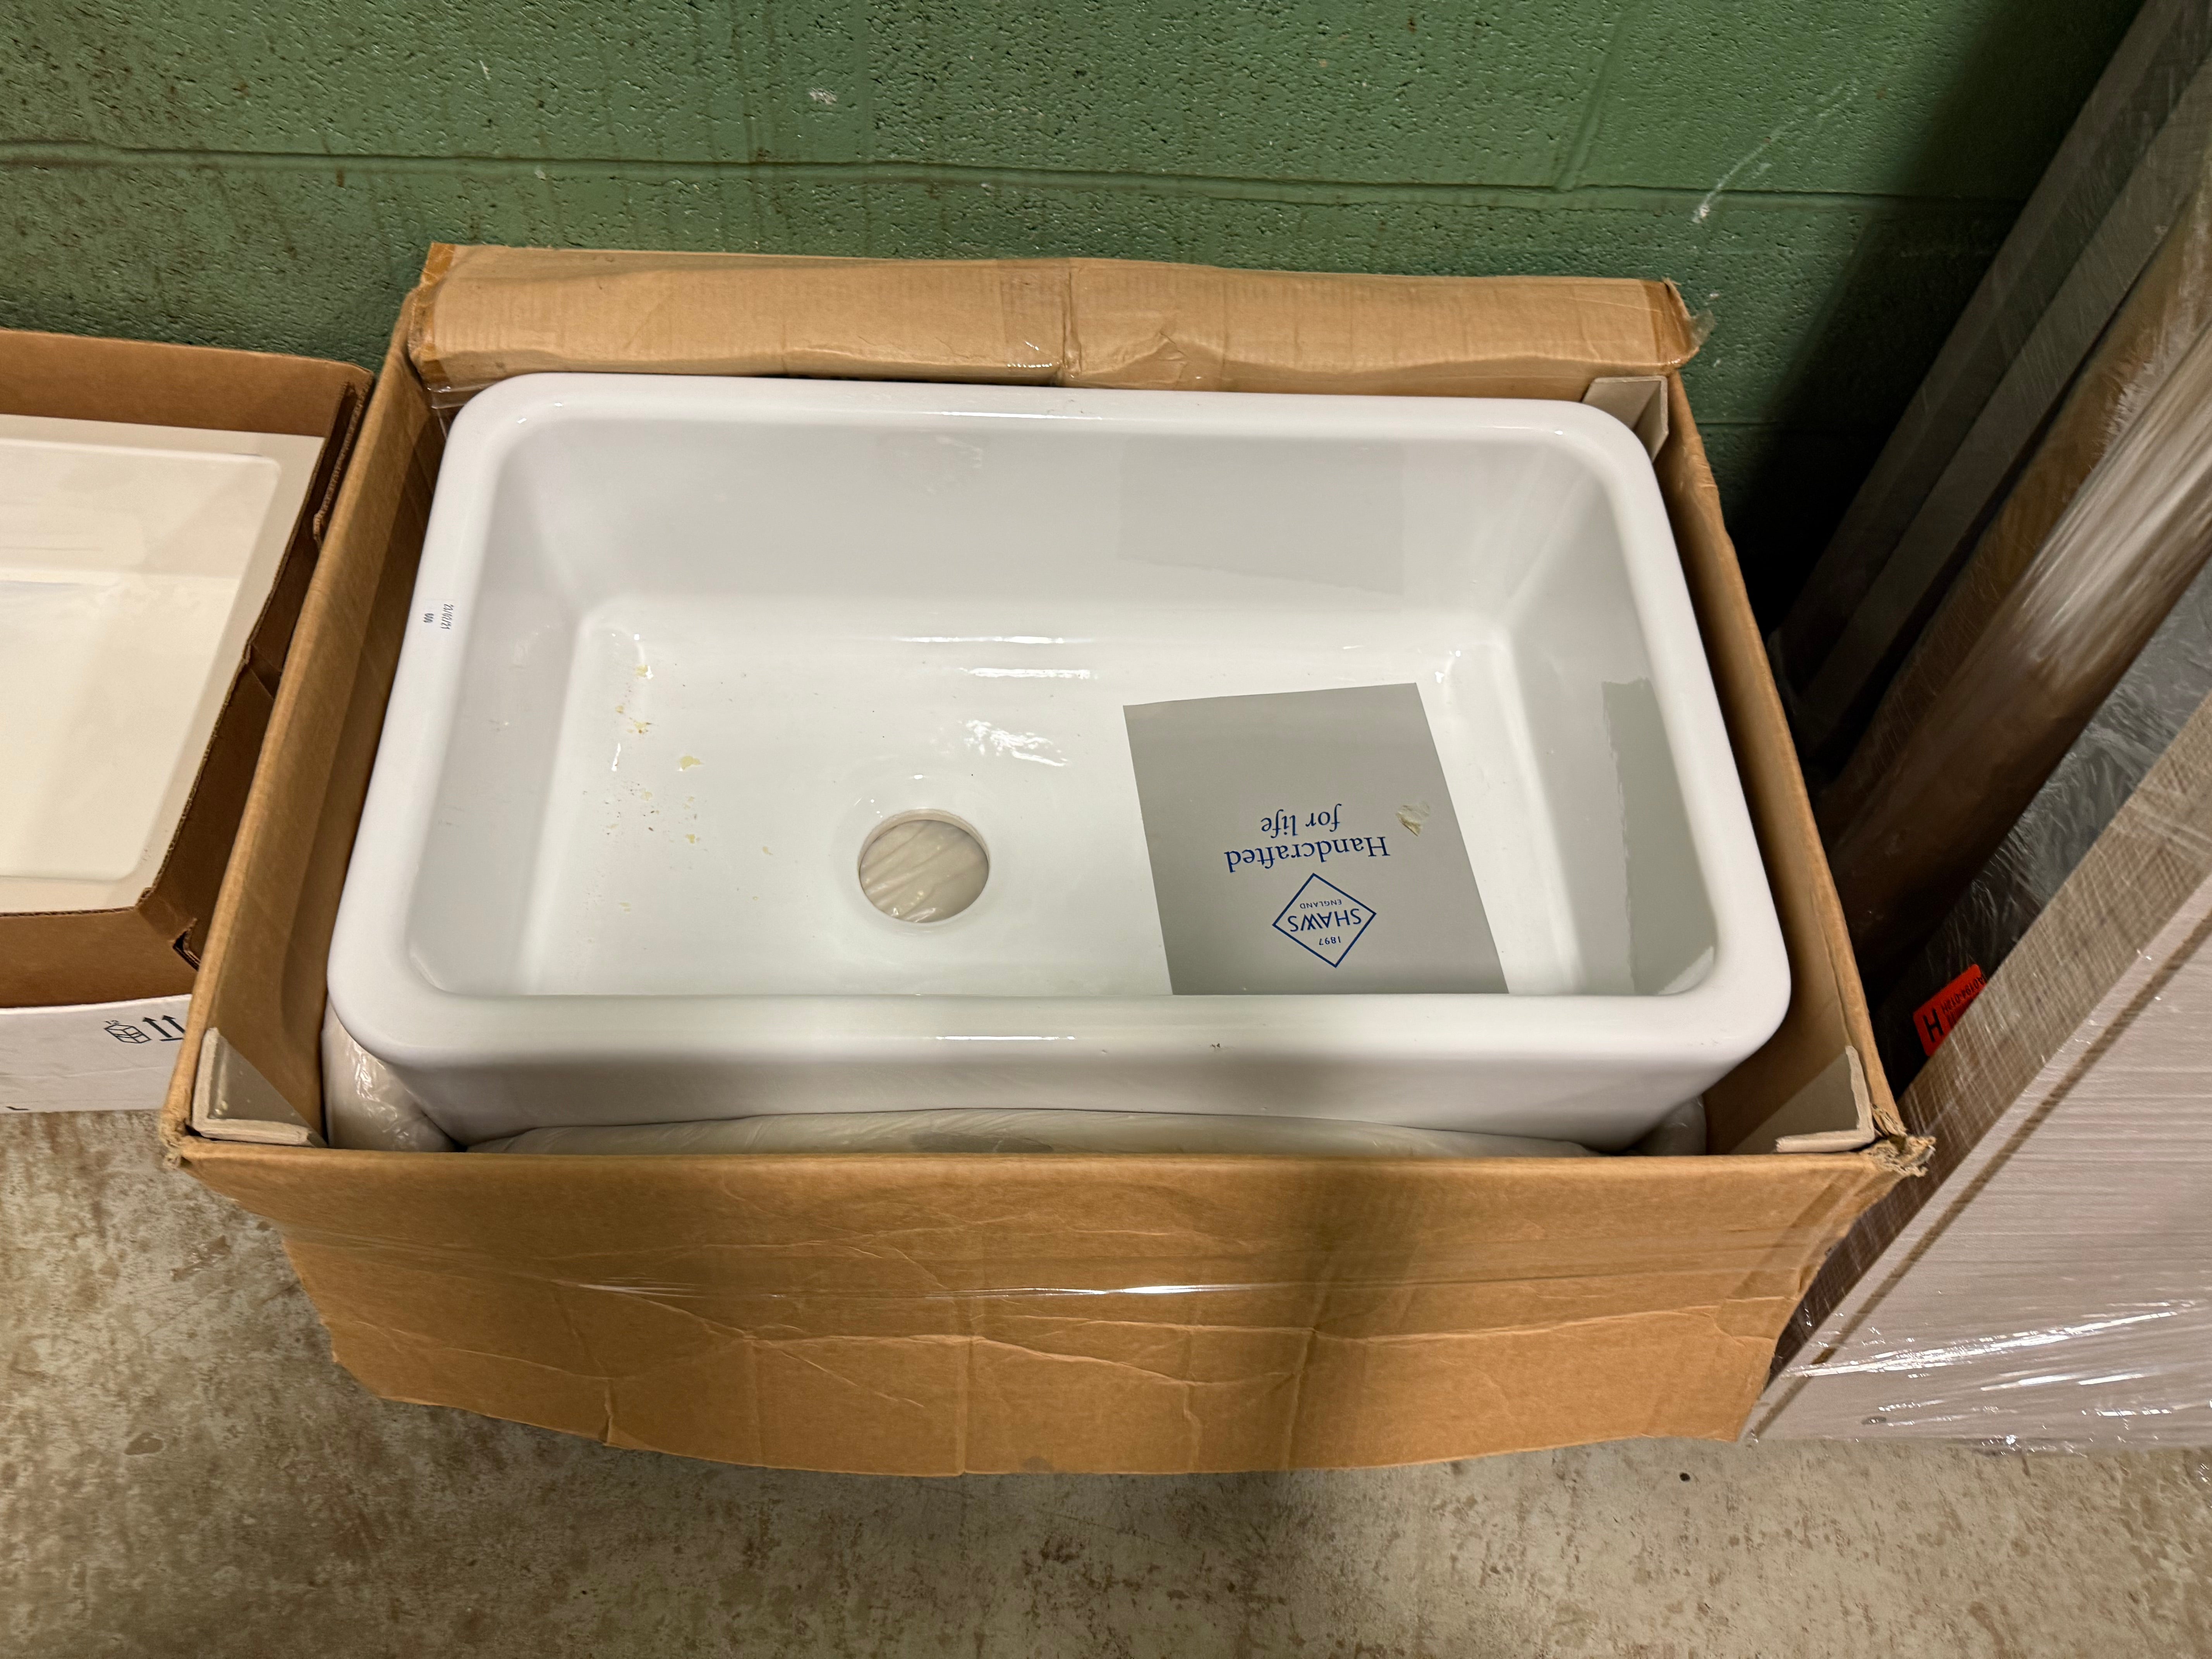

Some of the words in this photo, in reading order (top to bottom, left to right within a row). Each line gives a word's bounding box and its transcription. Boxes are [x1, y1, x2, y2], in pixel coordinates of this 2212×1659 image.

[1261, 809, 1298, 838] life
[1305, 804, 1341, 832] for
[1224, 836, 1390, 872] Handcrafted
[1300, 899, 1342, 909] ENGLAND
[1288, 908, 1362, 932] SHAWS
[1319, 936, 1341, 945] 1897
[1923, 1008, 1944, 1042] H
